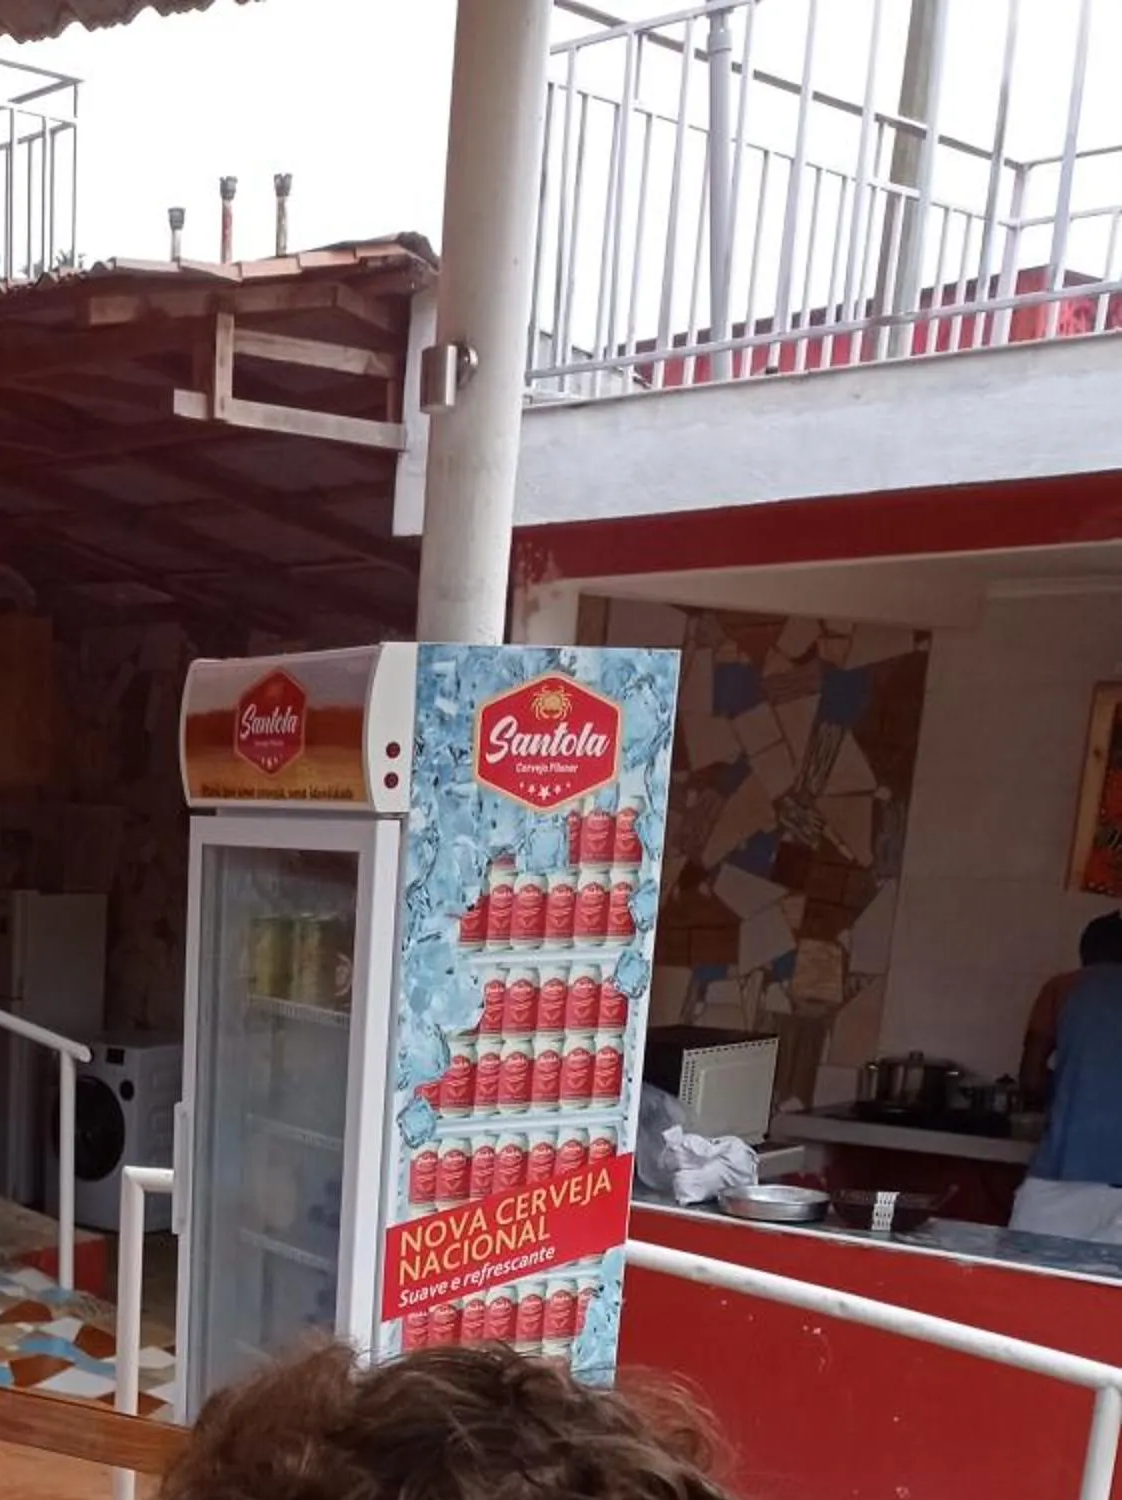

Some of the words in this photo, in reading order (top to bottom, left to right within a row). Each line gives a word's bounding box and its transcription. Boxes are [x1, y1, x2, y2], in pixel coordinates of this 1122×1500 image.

[485, 715, 611, 764] Santola
[515, 762, 548, 775] Cerveja
[400, 1207, 488, 1257] NOVA
[495, 1167, 612, 1226] CERVEJA
[398, 1280, 448, 1308] Suave
[451, 1276, 461, 1292] e
[463, 1245, 556, 1288] refrescante
[399, 1215, 551, 1286] NACIONAL
